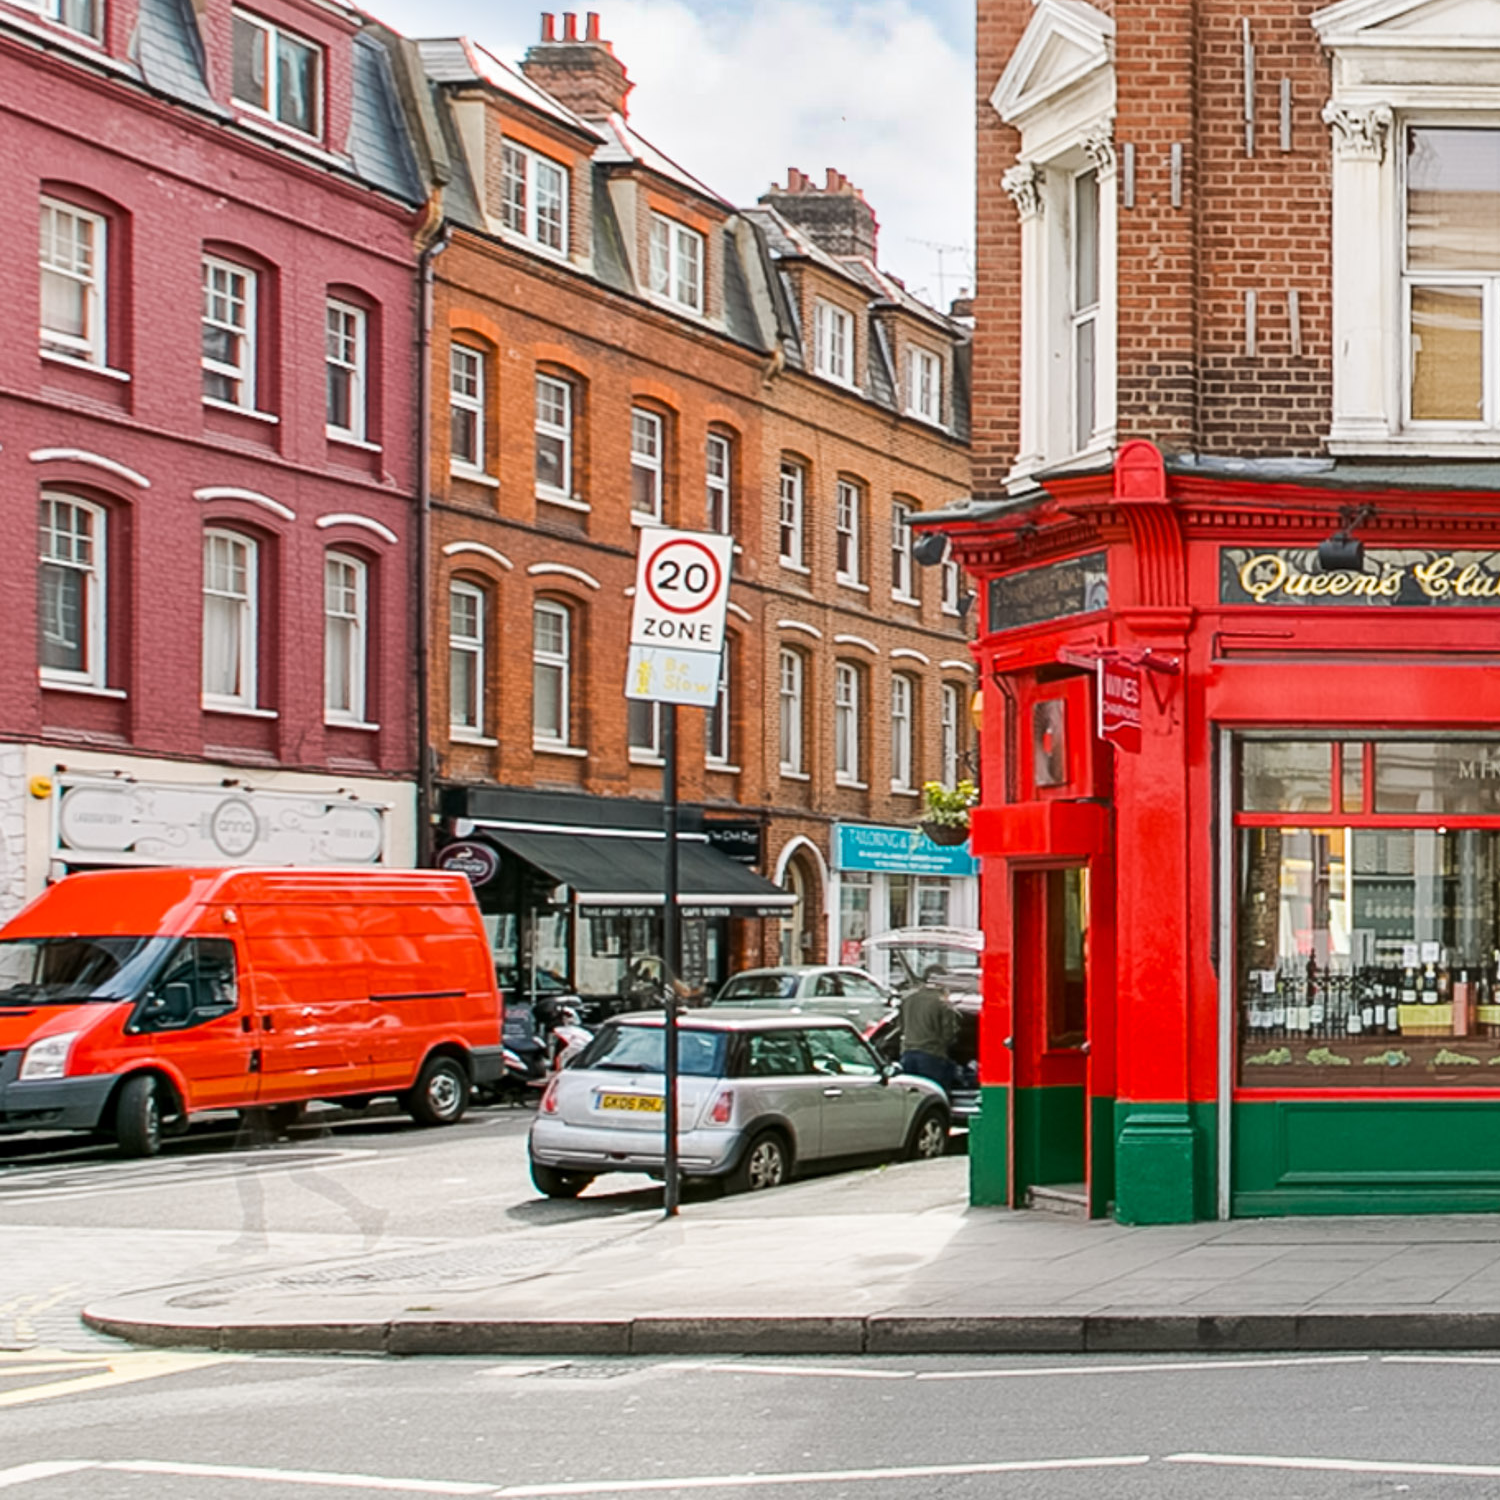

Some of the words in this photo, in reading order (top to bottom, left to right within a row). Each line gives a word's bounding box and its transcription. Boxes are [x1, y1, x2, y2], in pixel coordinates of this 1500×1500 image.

[657, 560, 708, 593] 20
[643, 618, 712, 642] ZONE
[664, 657, 690, 675] Be
[663, 673, 711, 693] Slow
